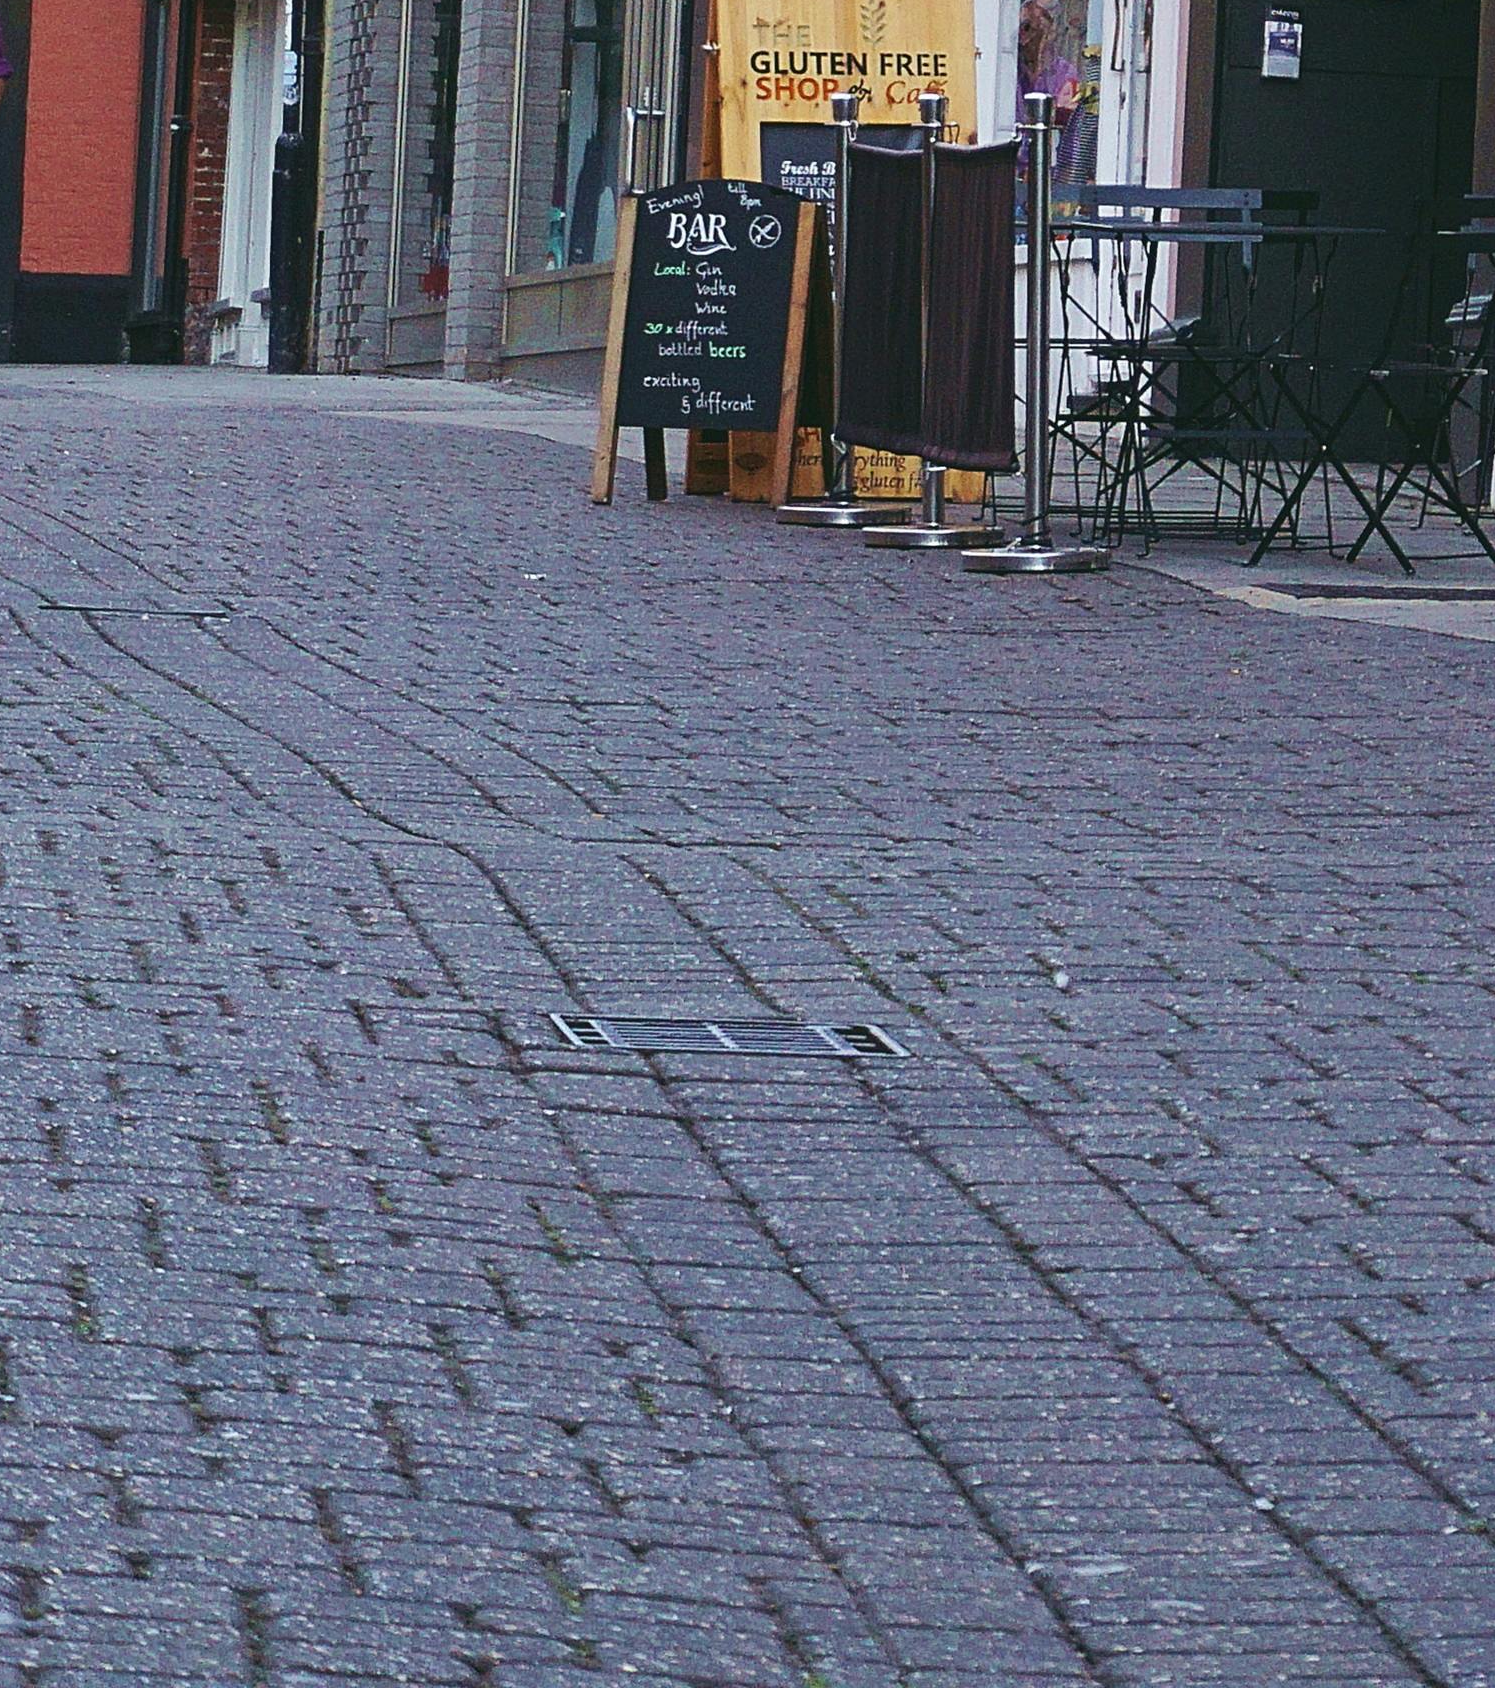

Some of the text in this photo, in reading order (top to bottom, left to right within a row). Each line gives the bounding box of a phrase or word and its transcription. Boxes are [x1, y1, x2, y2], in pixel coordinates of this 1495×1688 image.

[753, 18, 812, 47] THE
[750, 51, 947, 77] GLUTEN FREE
[756, 77, 840, 101] SHOP
[780, 161, 819, 176] Fresh
[667, 212, 737, 255] BAR
[695, 262, 723, 281] Gin
[675, 320, 729, 341] different
[658, 341, 747, 358] bottled beers
[643, 373, 701, 392] exciting
[696, 391, 756, 414] different
